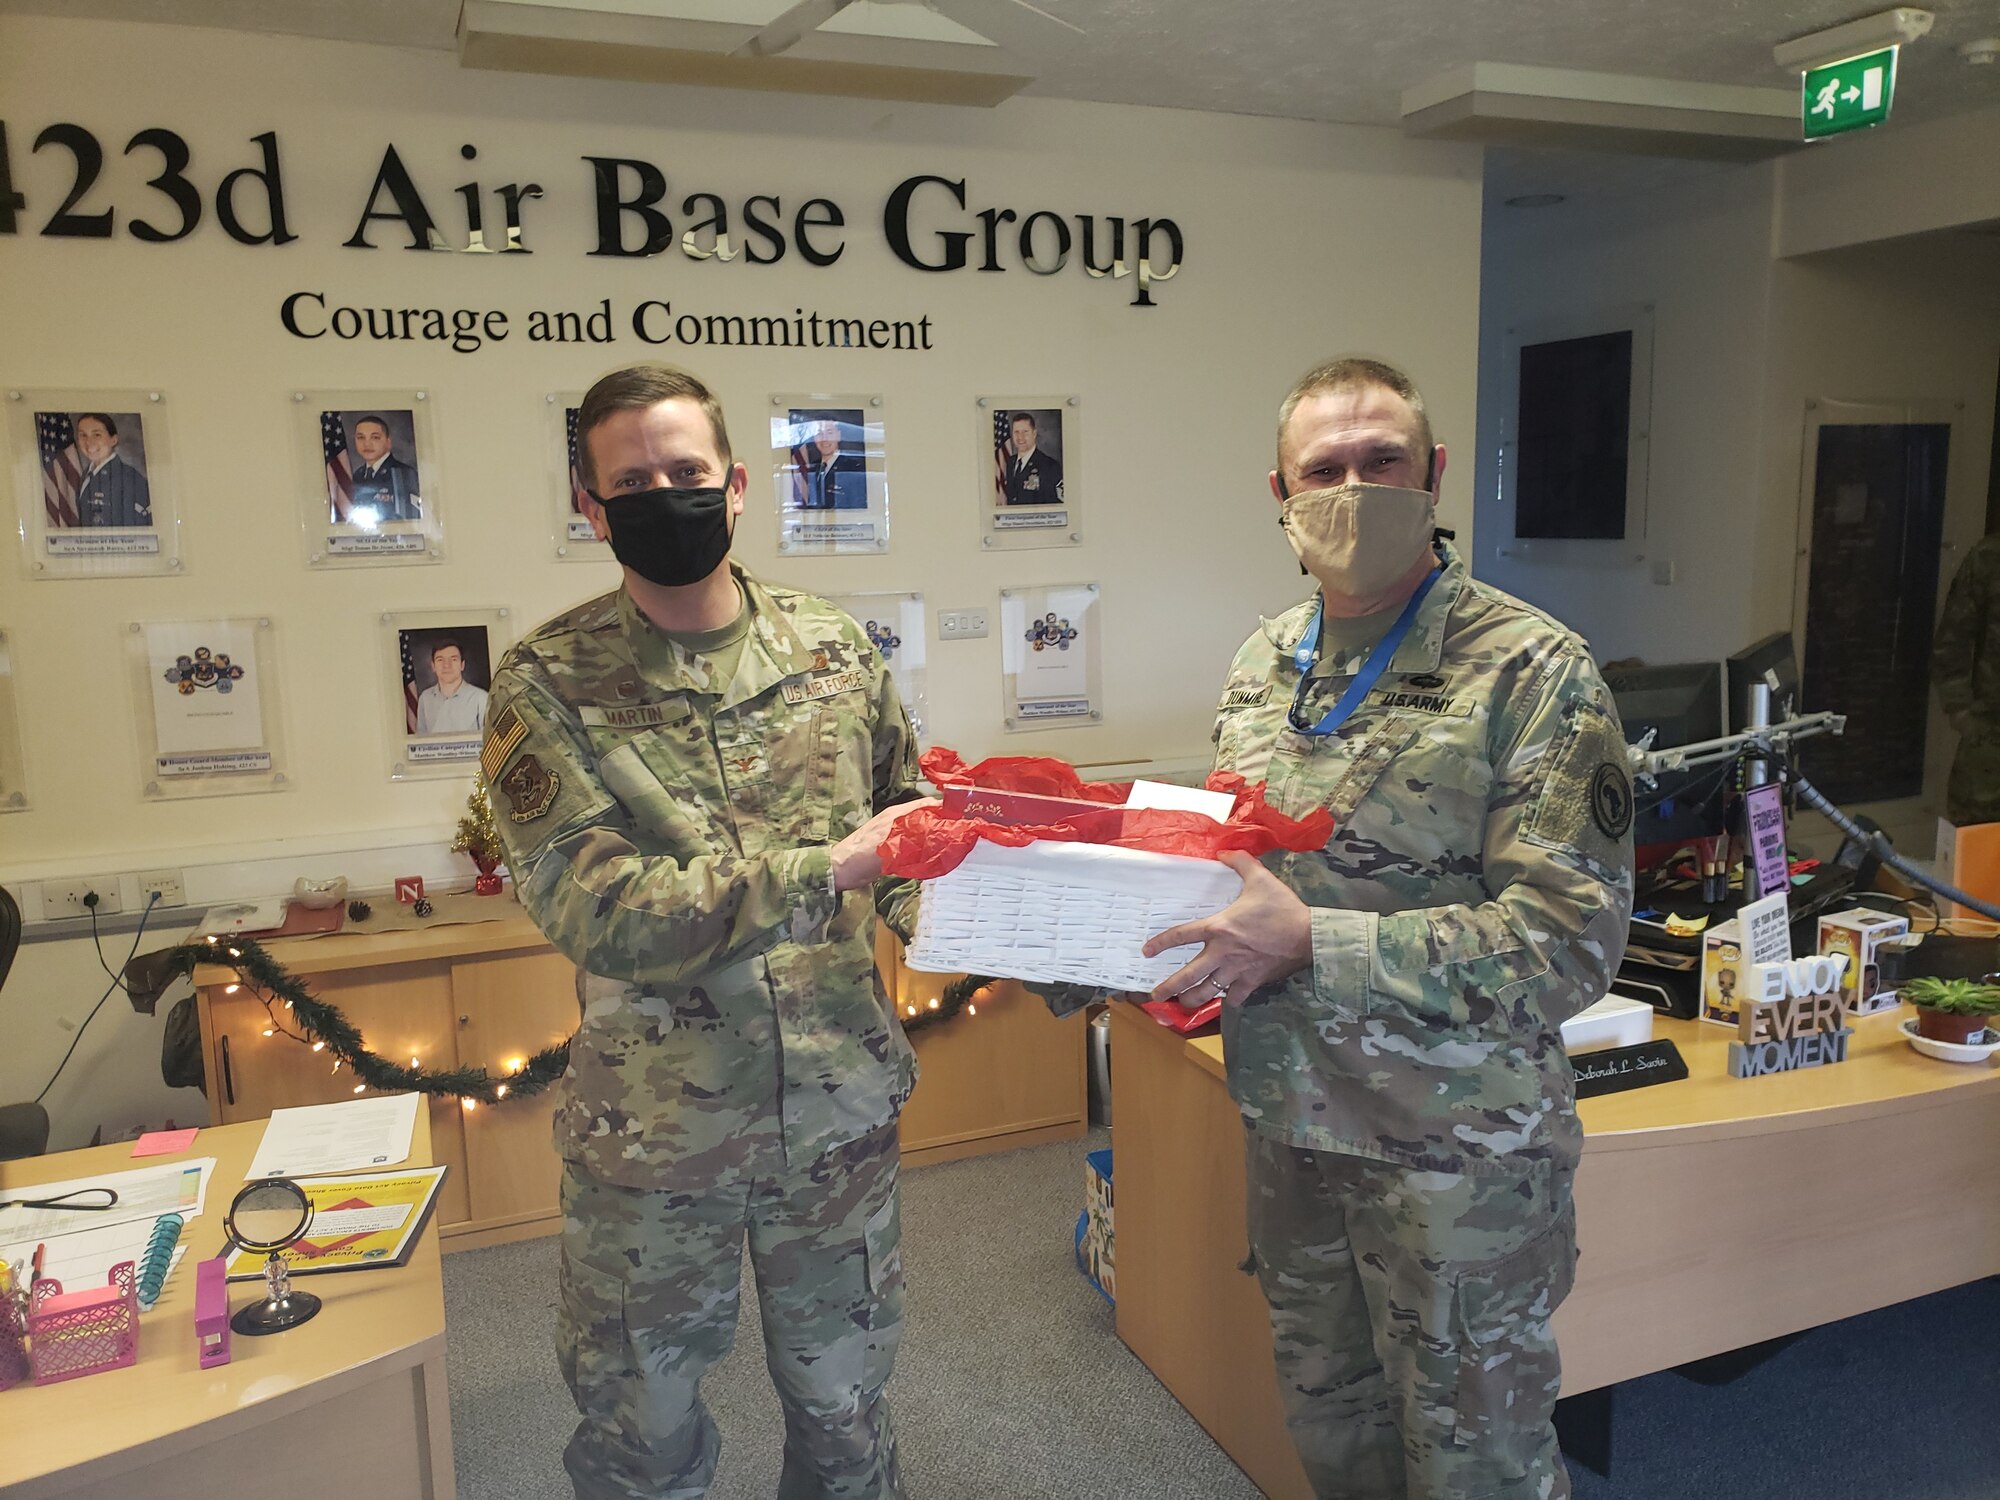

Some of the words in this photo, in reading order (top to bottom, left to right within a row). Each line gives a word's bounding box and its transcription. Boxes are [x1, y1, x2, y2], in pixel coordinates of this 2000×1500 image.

[342, 142, 543, 254] Air
[581, 155, 846, 267] Base
[884, 174, 1184, 306] Group
[281, 291, 509, 353] Courage
[528, 299, 614, 343] and
[632, 300, 933, 351] Commitment
[805, 681, 826, 698] AIR
[825, 671, 863, 693] FORCE
[604, 705, 664, 726] MARTIN
[400, 882, 419, 902] N
[1757, 953, 1850, 1004] ENJOY
[1748, 989, 1857, 1046] EVERY
[1574, 1061, 1619, 1082] Deborah
[1737, 1027, 1855, 1079] MOMENT
